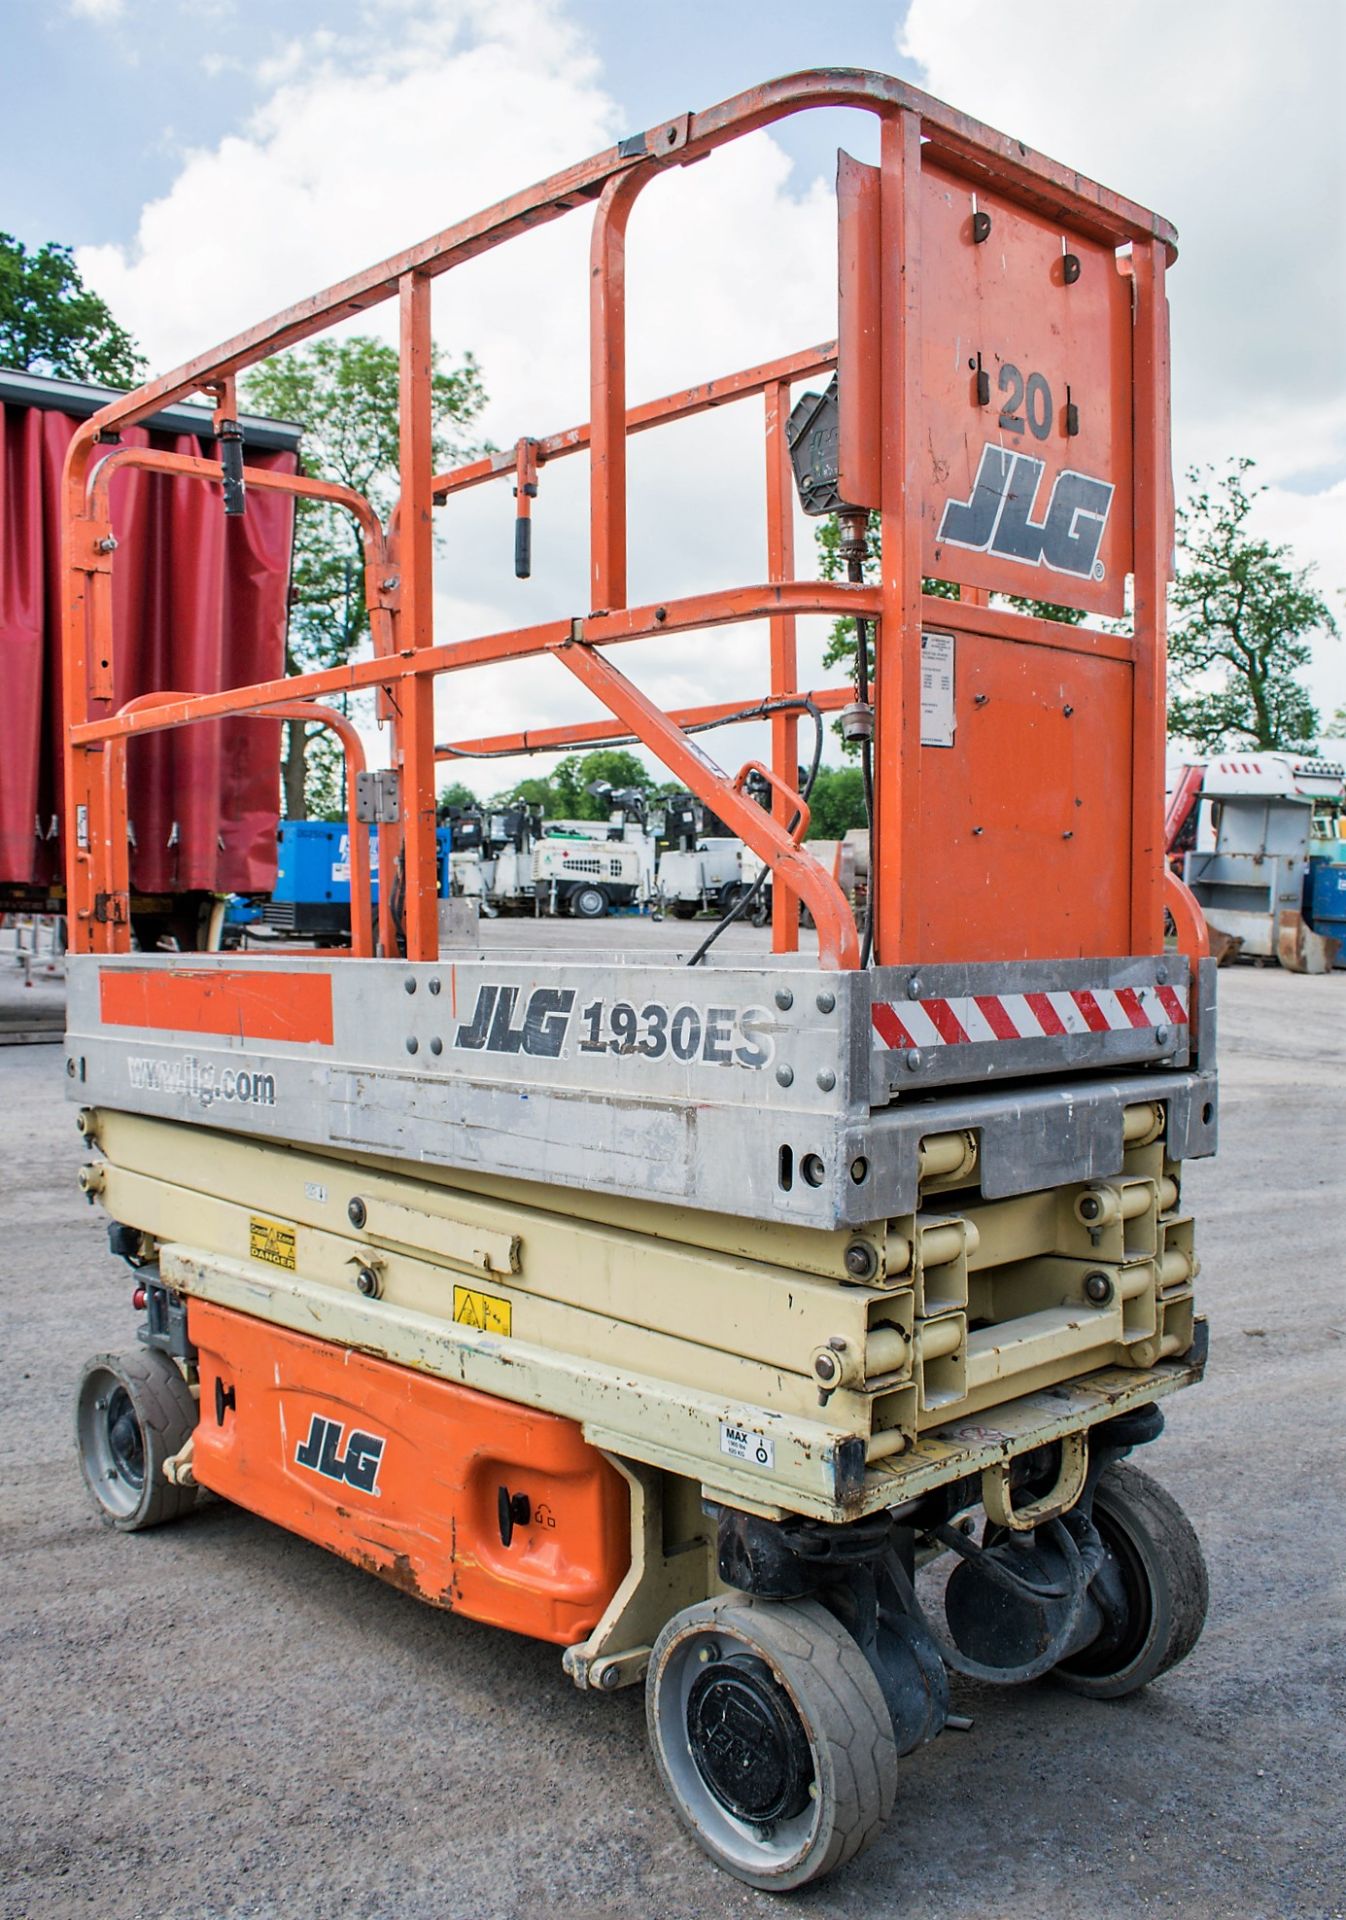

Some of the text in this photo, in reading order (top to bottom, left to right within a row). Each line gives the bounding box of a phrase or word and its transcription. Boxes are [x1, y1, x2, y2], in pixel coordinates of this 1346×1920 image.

[998, 363, 1053, 441] 20
[936, 442, 1116, 580] JLG
[453, 984, 776, 1071] JLG 1930ES
[251, 1248, 295, 1268] DANGER
[295, 1412, 386, 1496] JLG
[726, 1427, 748, 1444] MAX
